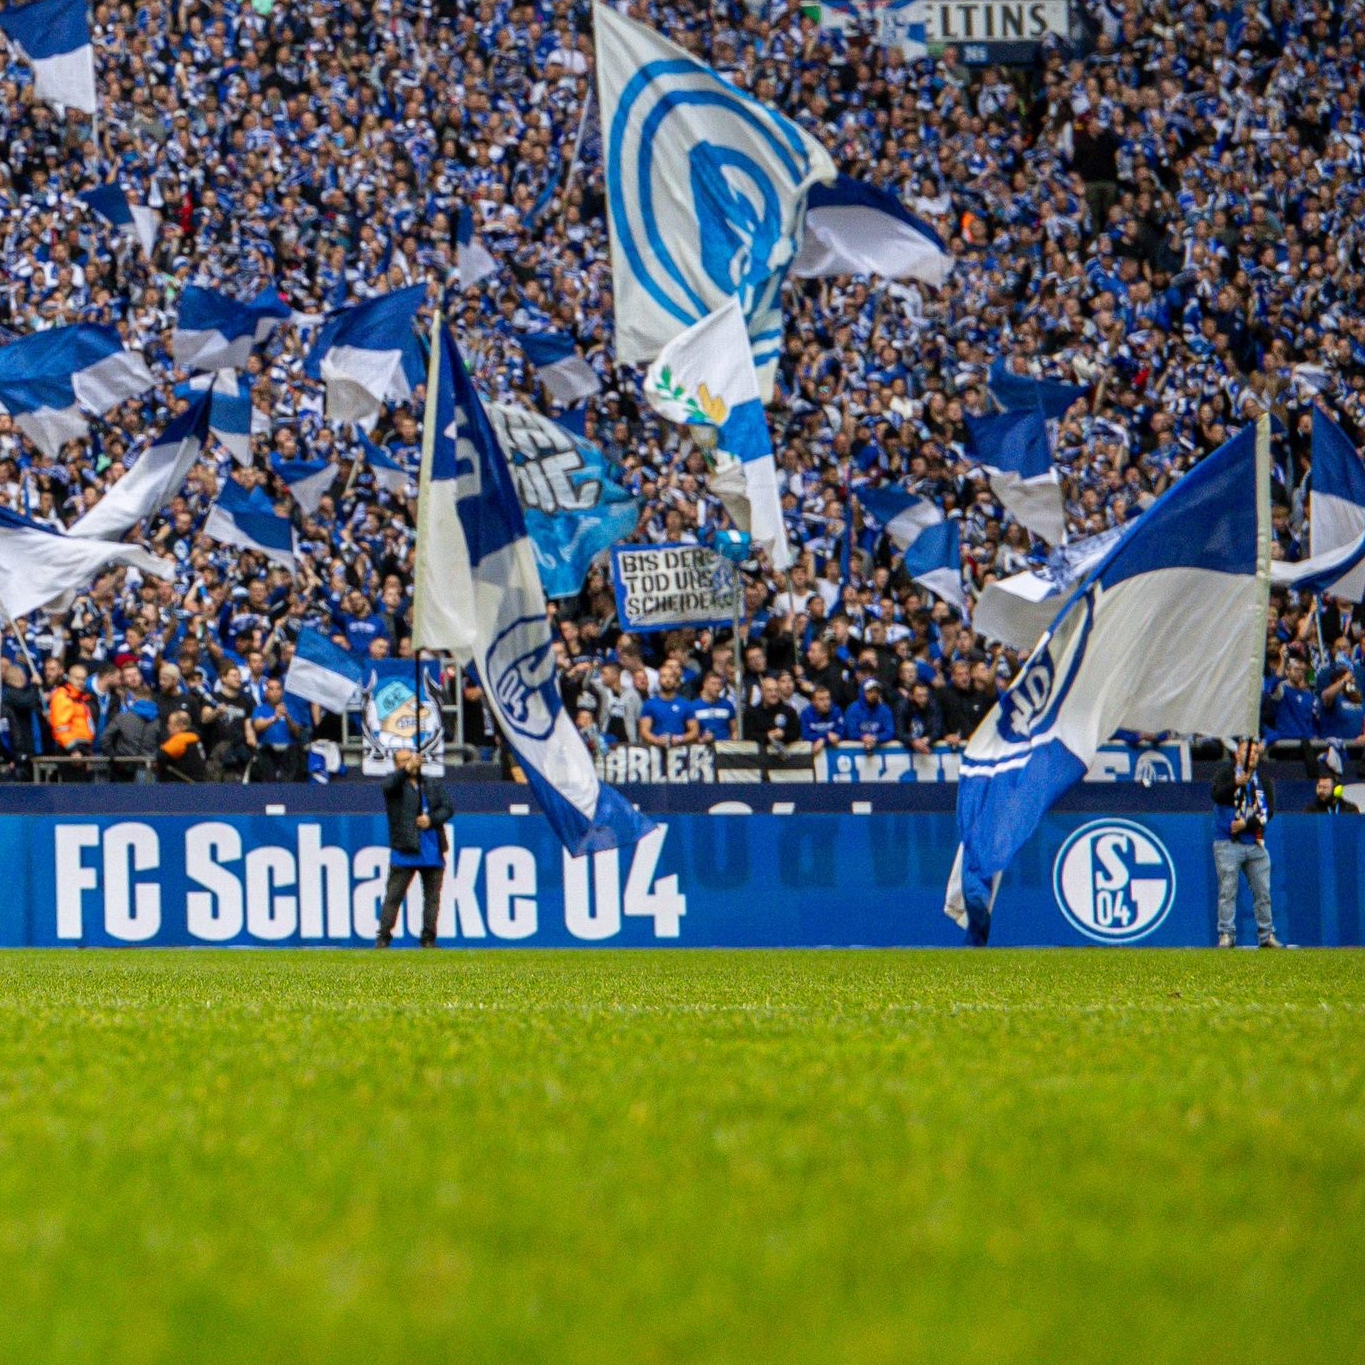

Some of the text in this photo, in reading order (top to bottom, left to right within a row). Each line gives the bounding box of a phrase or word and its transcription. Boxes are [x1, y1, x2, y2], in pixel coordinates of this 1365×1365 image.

[926, 3, 1049, 37] LTINS
[622, 553, 659, 573] BIS
[625, 573, 670, 594] TOD
[1095, 834, 1130, 891] S
[55, 822, 162, 940] FC
[564, 823, 687, 942] 04
[1095, 890, 1131, 927] 04
